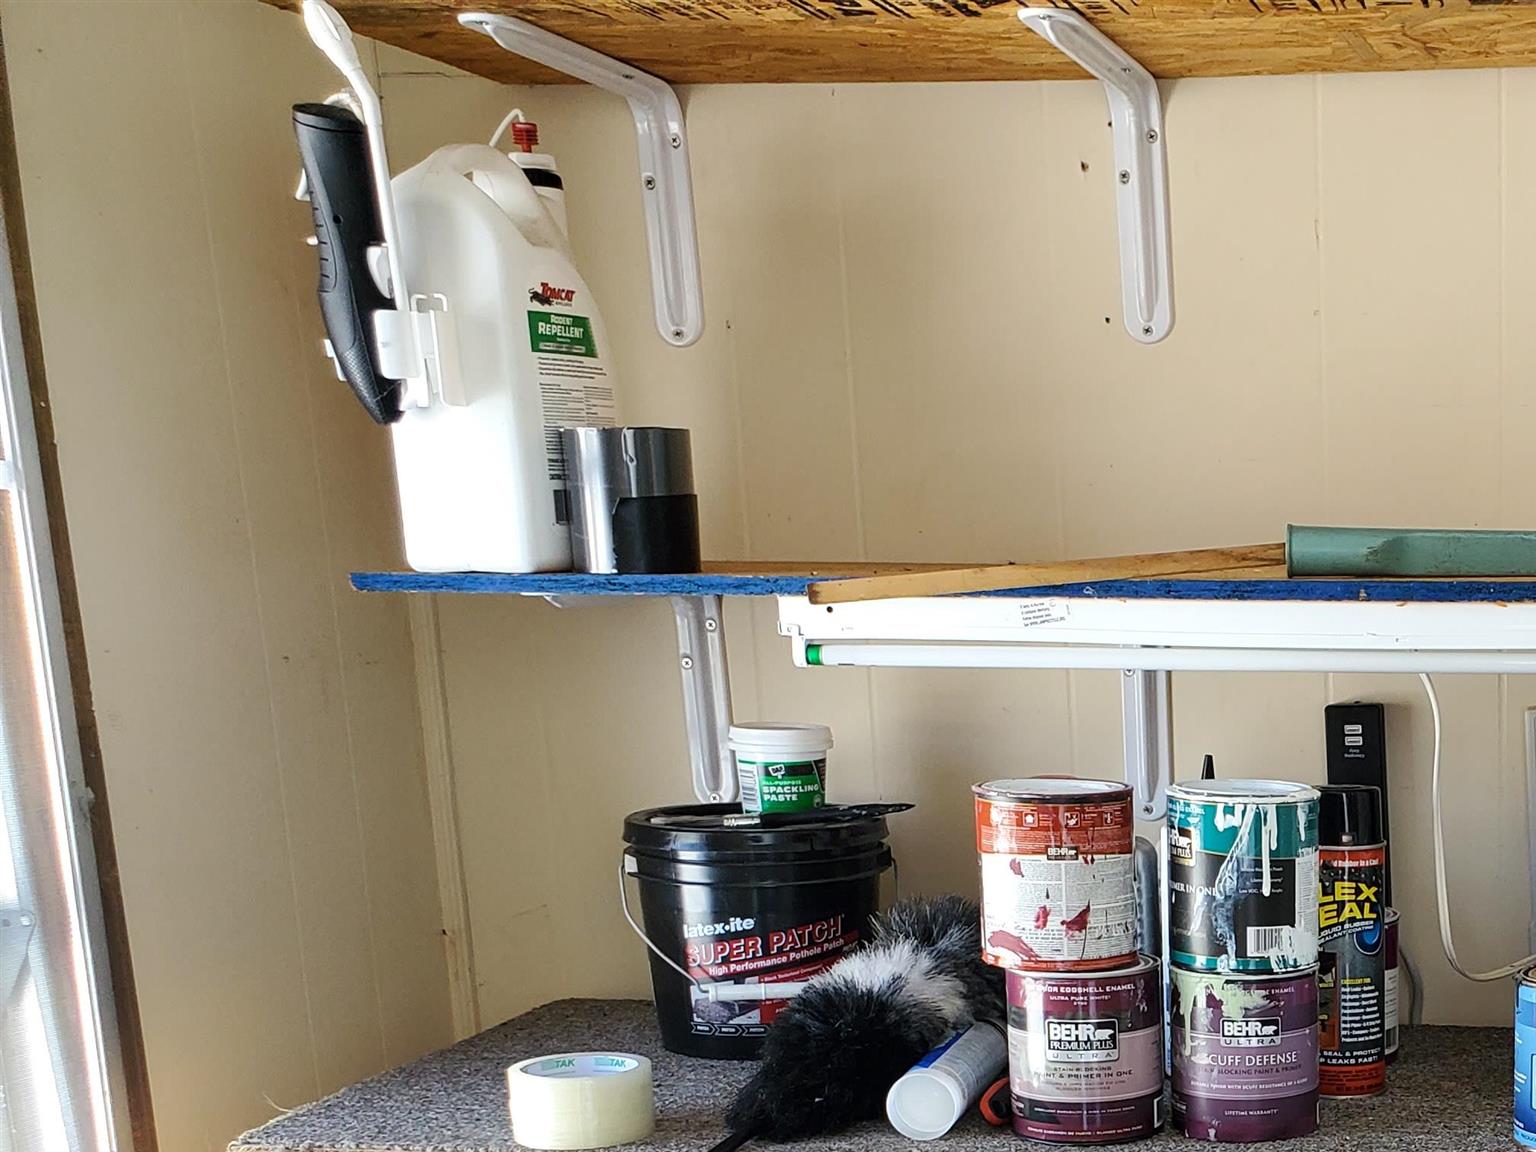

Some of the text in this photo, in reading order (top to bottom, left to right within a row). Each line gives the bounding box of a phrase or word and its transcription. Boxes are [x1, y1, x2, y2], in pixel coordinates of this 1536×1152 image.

[540, 281, 576, 303] TOMCAT
[550, 314, 574, 326] RODENT
[538, 321, 584, 339] REPELLENT
[762, 784, 820, 794] SPACKLING
[764, 793, 799, 802] PASTE
[1047, 847, 1069, 856] BEHR
[1318, 881, 1378, 903] LEX
[1320, 902, 1377, 928] EAL
[686, 914, 843, 967] SUPER PATCH
[709, 966, 729, 977] High
[730, 955, 788, 973] Performance
[789, 947, 822, 961] Pothole
[823, 938, 845, 951] Patch
[1105, 983, 1136, 993] ENAMEL
[1050, 1023, 1095, 1042] BEHR
[1223, 1021, 1262, 1037] BEHR
[1050, 1040, 1114, 1050] PREMIUM PLUS
[1224, 1038, 1277, 1046] ULTRA
[1052, 1052, 1113, 1060] ULTRA
[1352, 1047, 1381, 1057] PROTECT
[554, 1058, 627, 1068] TAK TAK
[1207, 1051, 1298, 1067] CUFF DEFENSE
[1327, 1057, 1356, 1065] LEAKS
[1116, 1069, 1133, 1077] ONE
